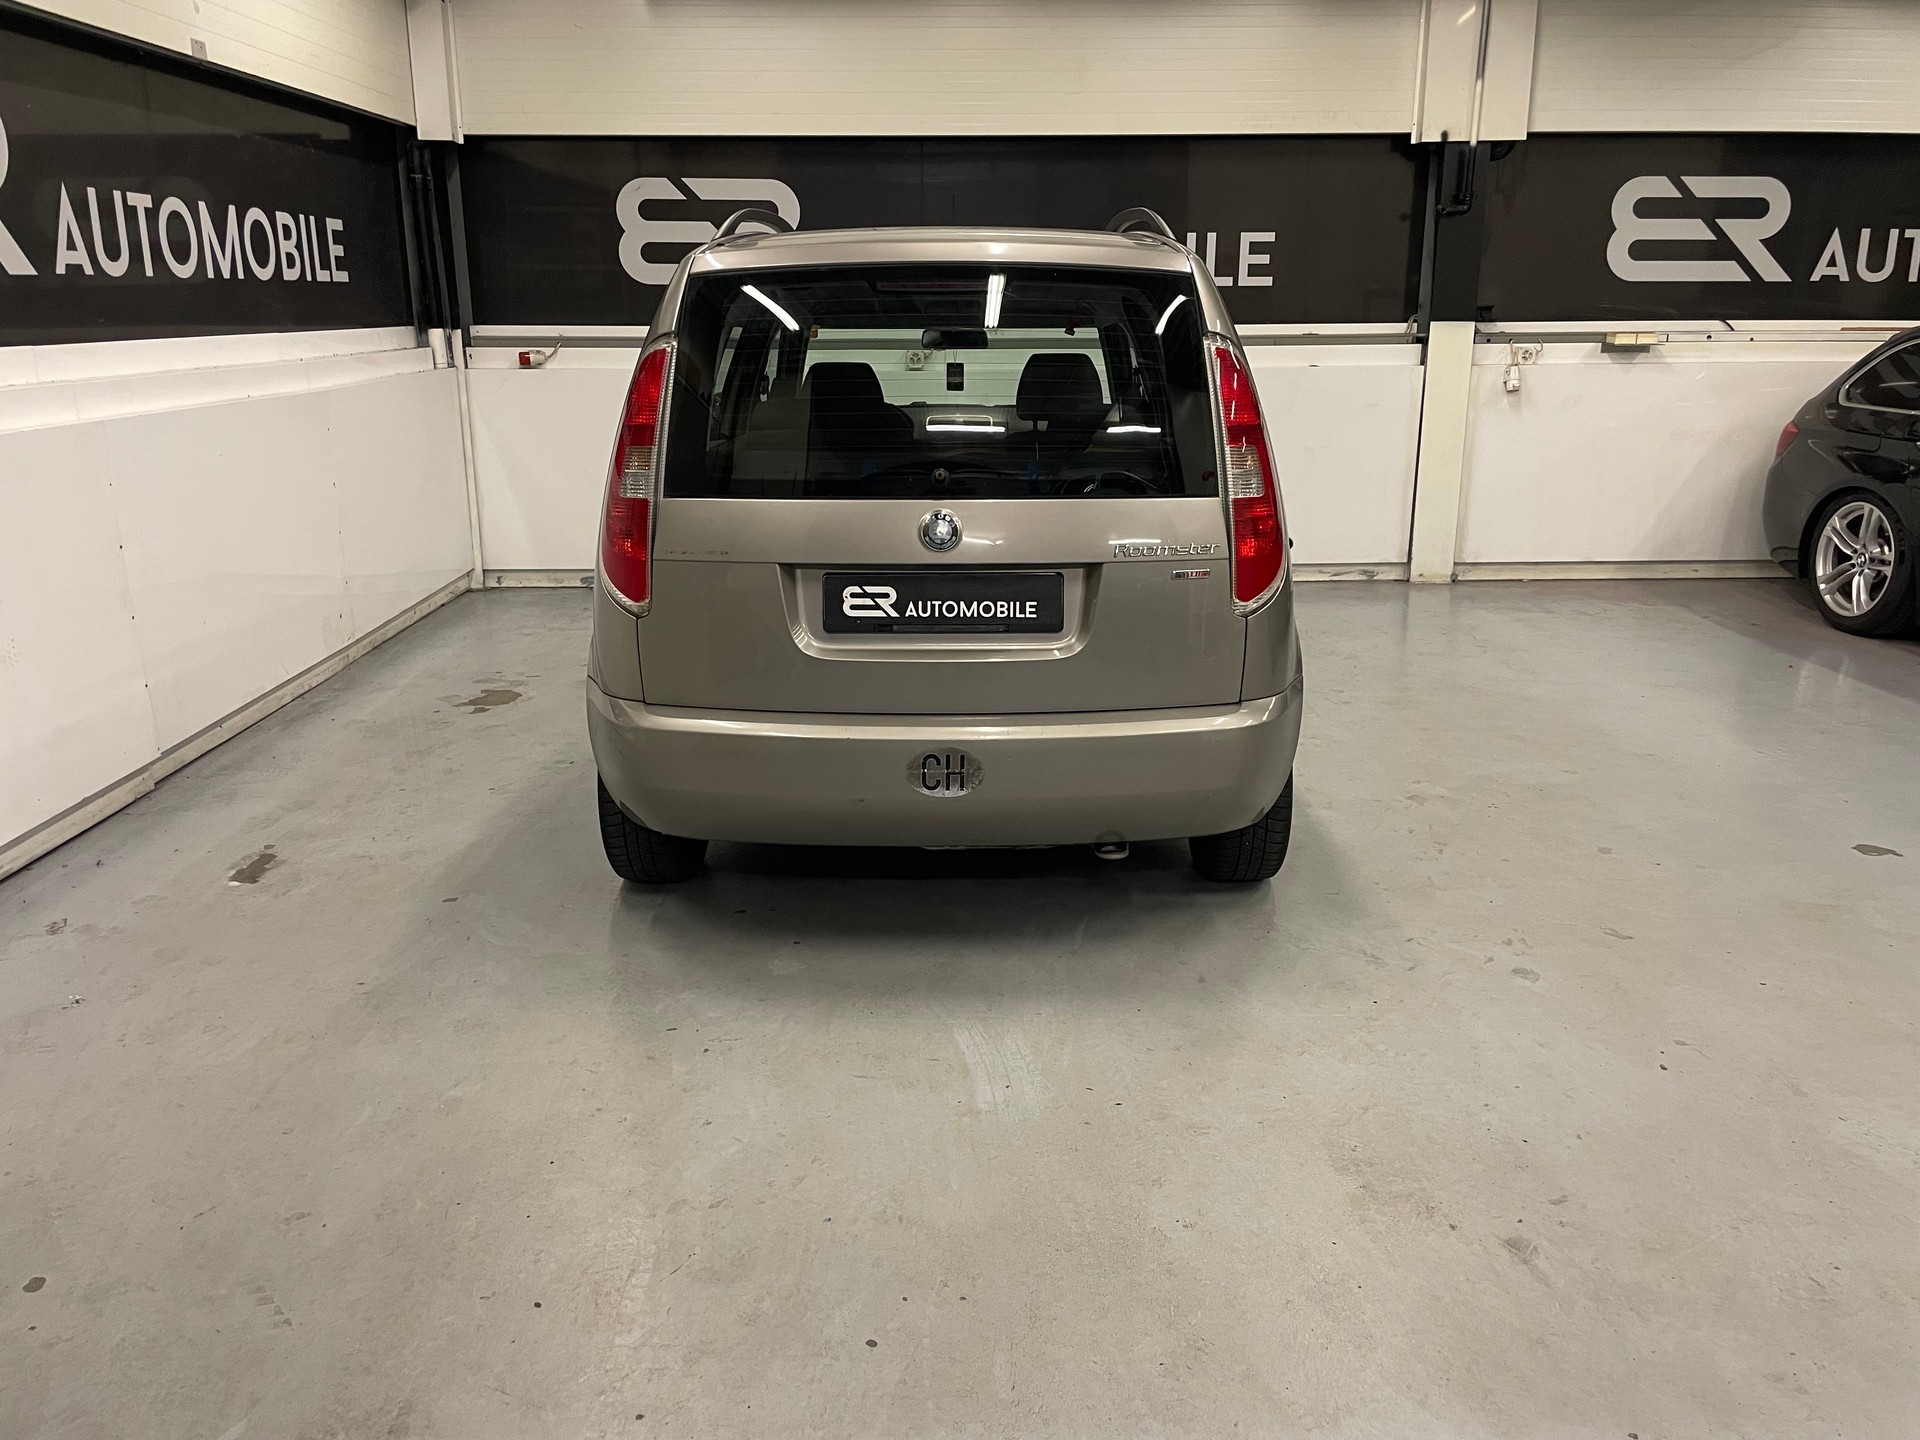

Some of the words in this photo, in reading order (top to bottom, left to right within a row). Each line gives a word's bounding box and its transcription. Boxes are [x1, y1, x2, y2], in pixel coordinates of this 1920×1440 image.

[55, 181, 349, 283] AUTOMOBILE
[1606, 175, 1793, 282] ER
[1809, 227, 1920, 283] AUT
[1113, 542, 1221, 558] Roomster
[842, 586, 900, 618] ER
[905, 600, 1038, 618] AUTOMOBILE
[921, 753, 966, 792] CH
